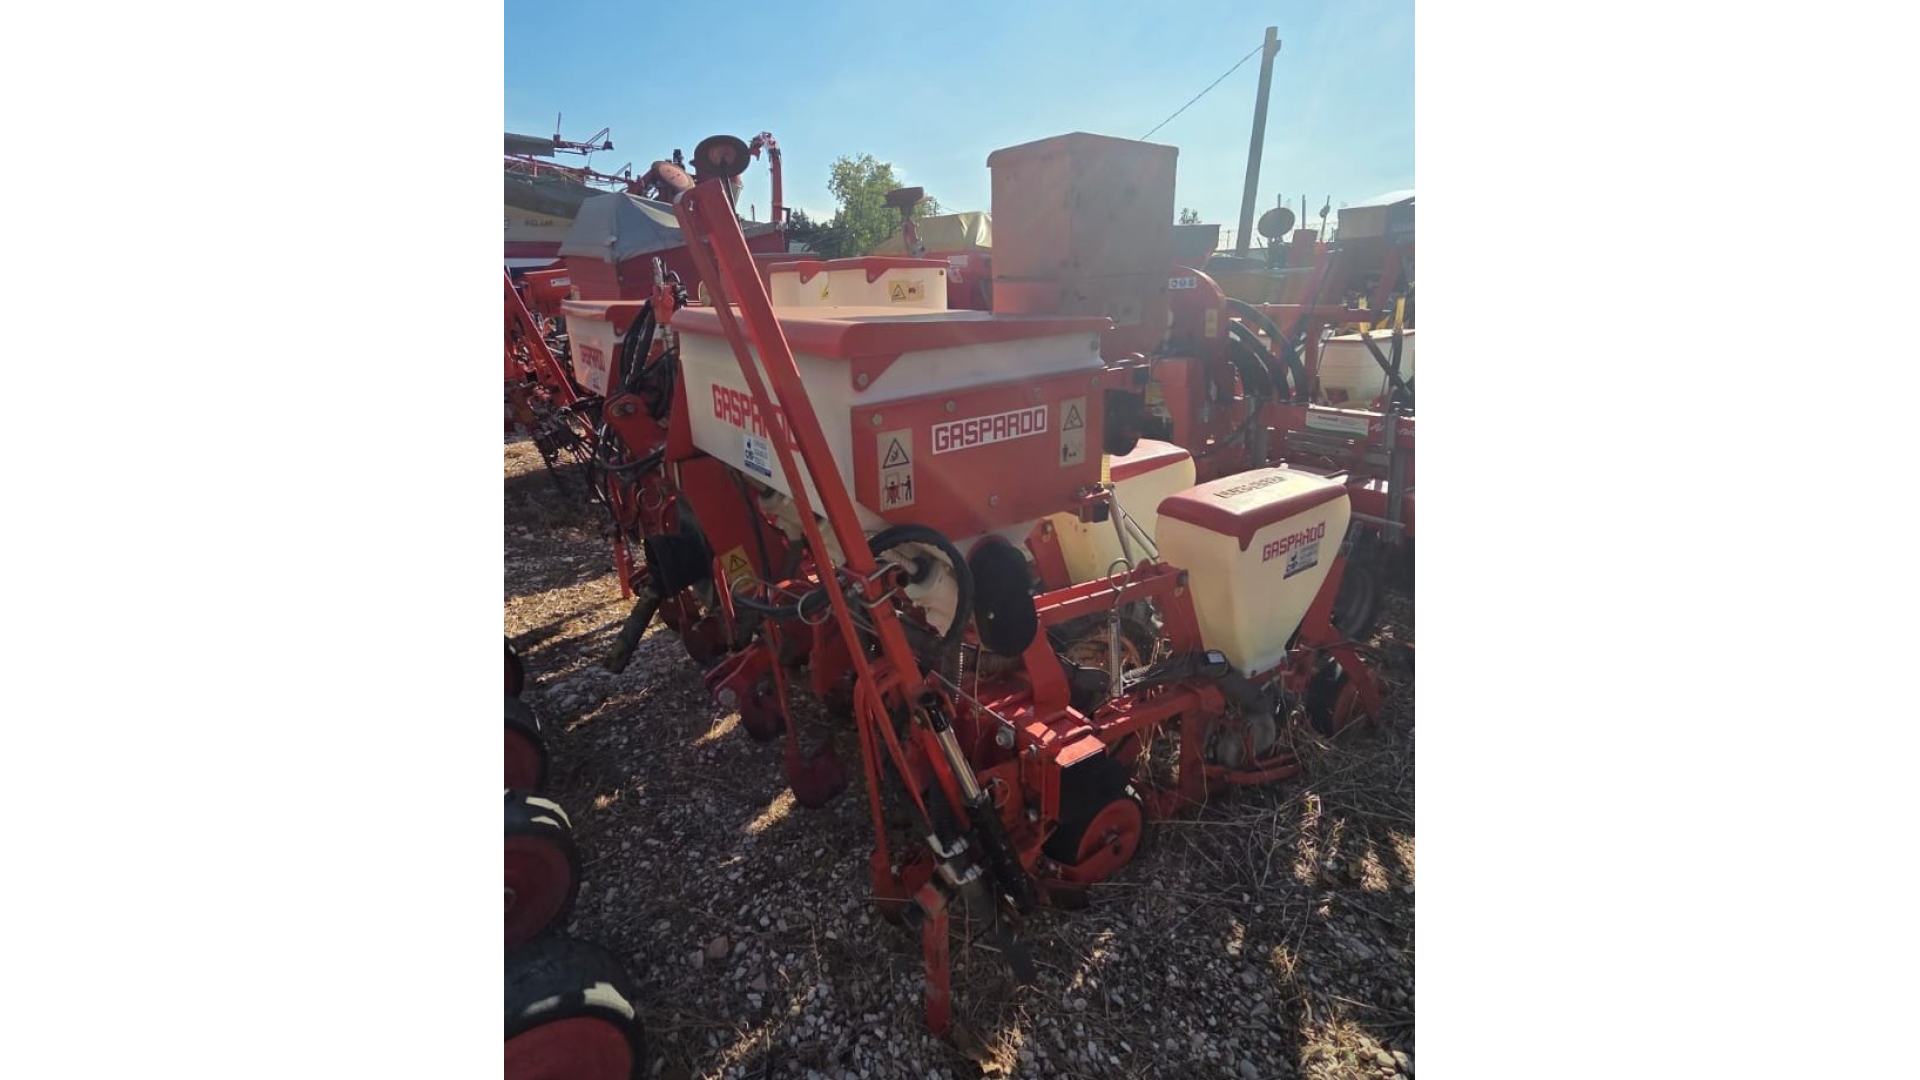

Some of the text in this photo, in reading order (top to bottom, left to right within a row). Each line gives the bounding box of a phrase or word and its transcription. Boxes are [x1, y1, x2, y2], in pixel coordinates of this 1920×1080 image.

[712, 383, 801, 452] GASPADO
[935, 408, 1046, 451] GASPARDO
[1262, 522, 1326, 562] GASPARDO
